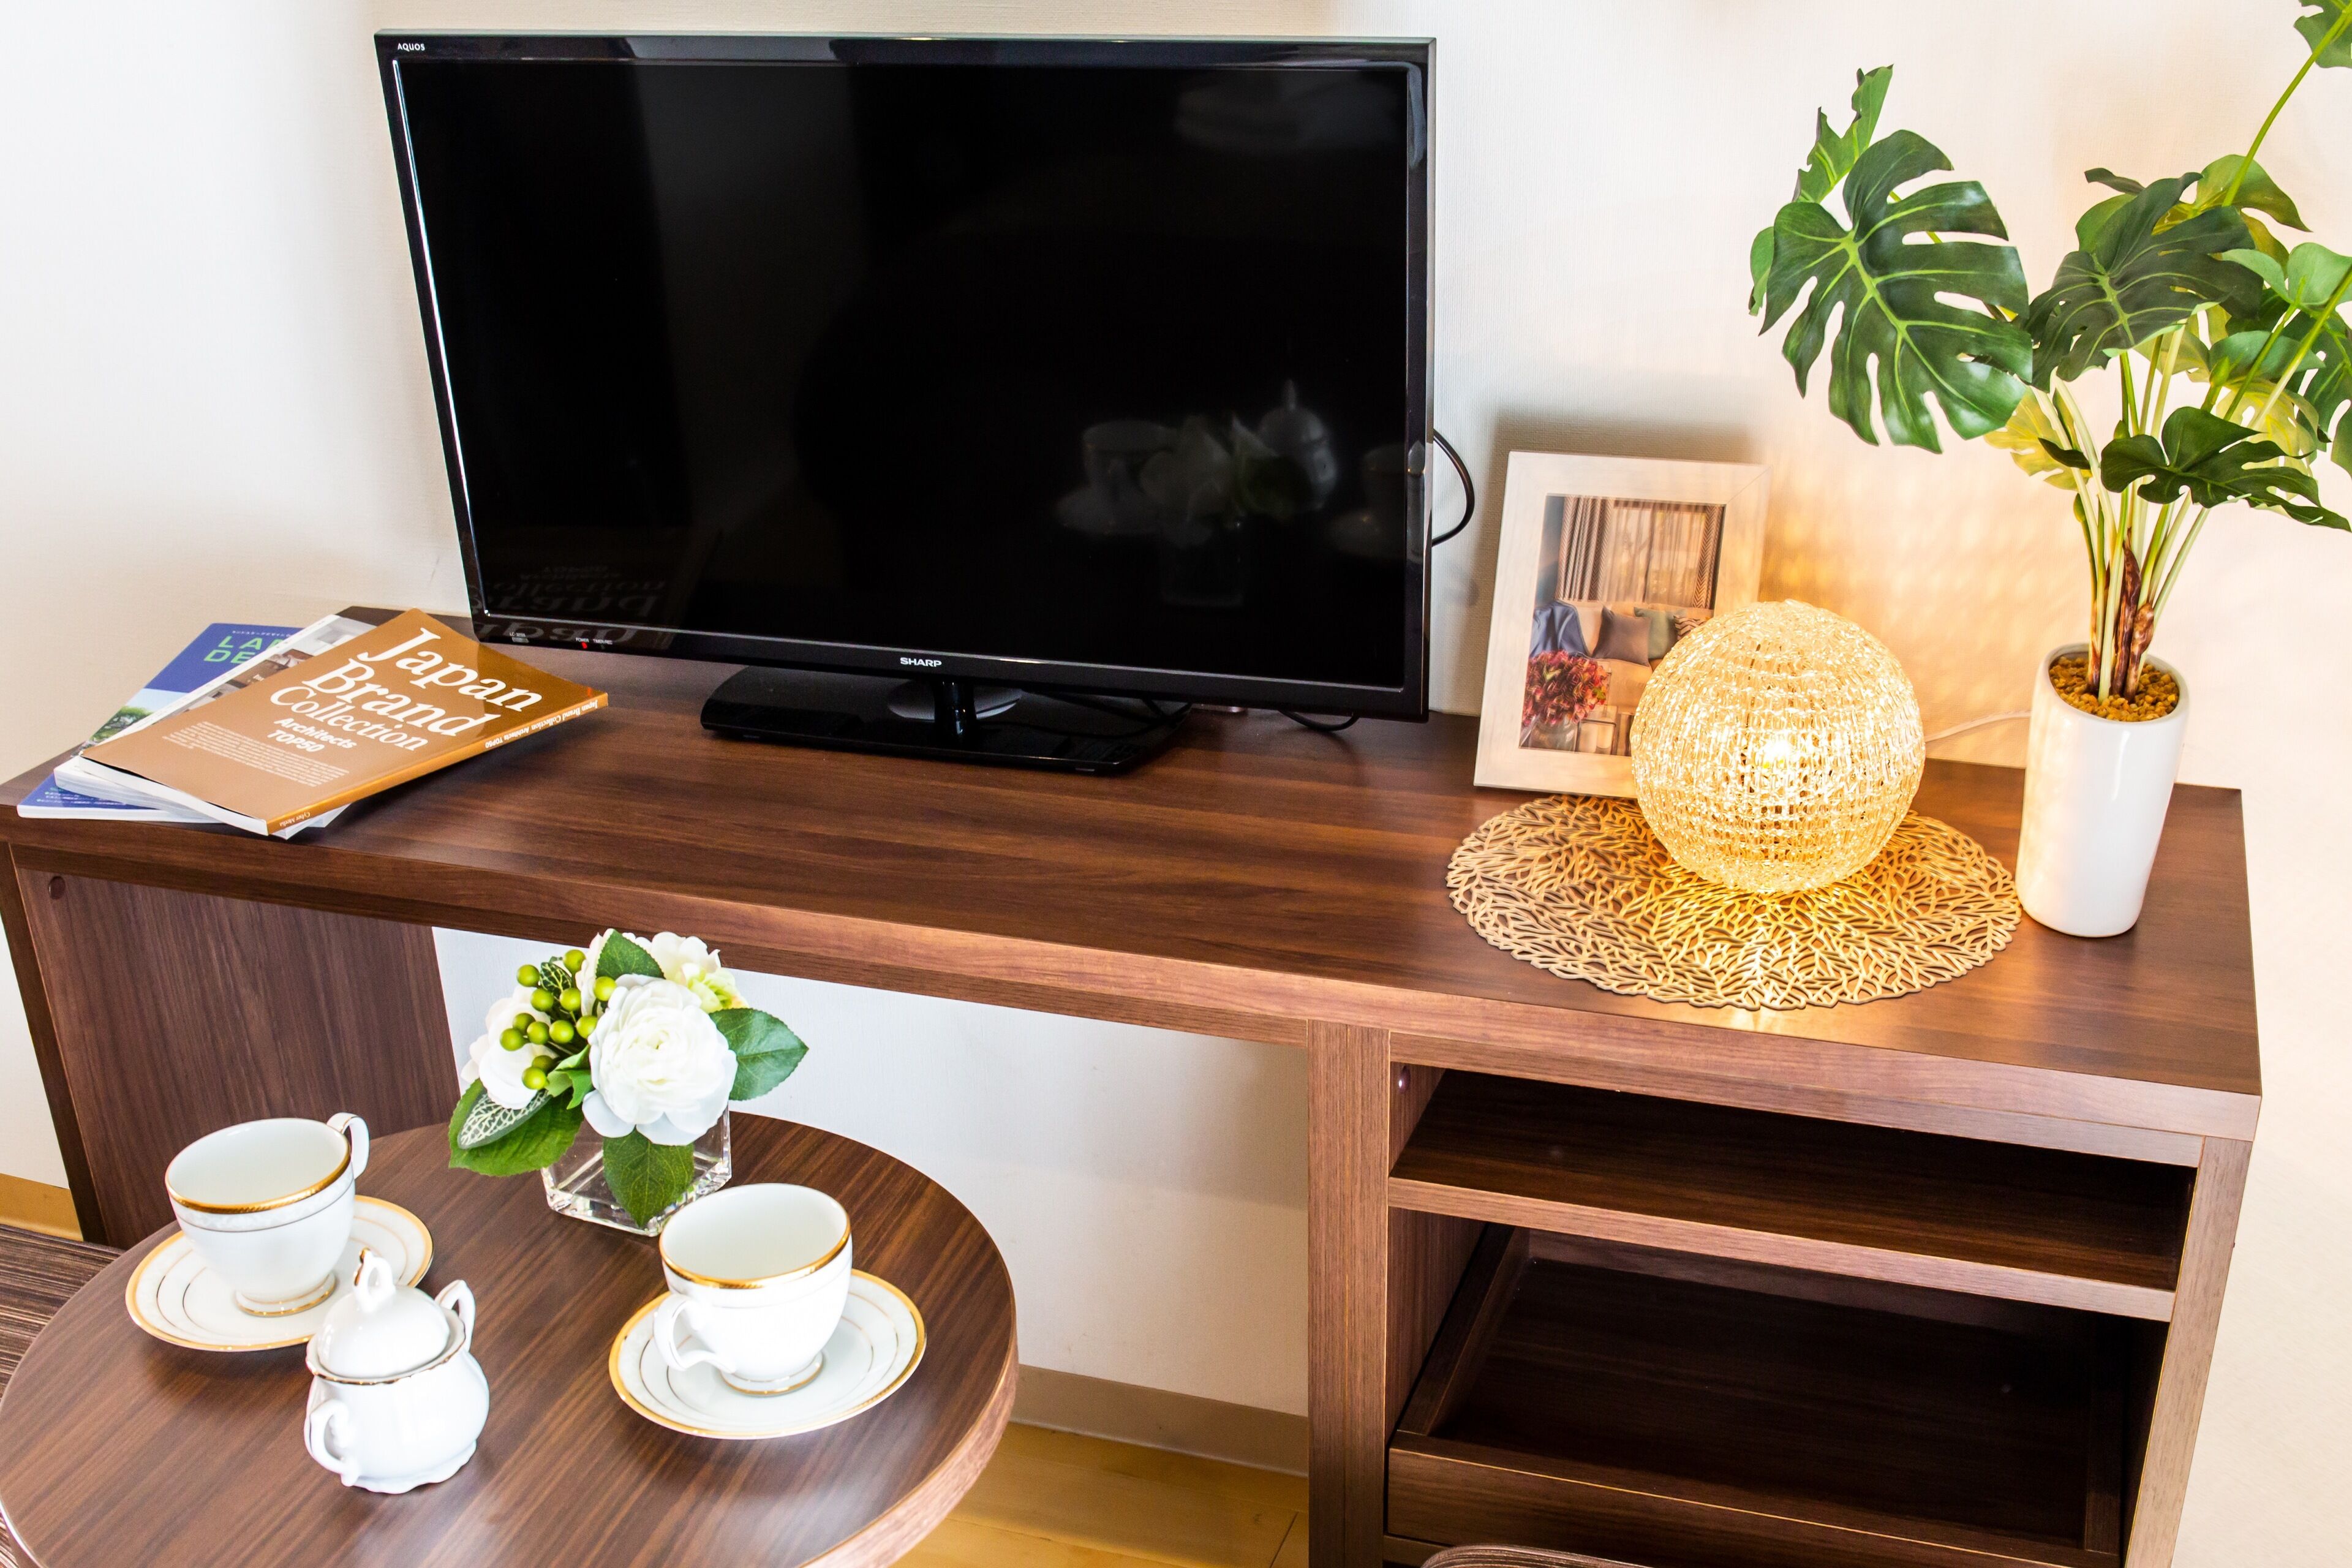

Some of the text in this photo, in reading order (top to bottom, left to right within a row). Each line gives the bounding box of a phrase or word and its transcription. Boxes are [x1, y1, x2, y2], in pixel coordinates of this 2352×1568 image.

[398, 43, 425, 51] AQUOS
[356, 627, 543, 712] Japan
[900, 657, 942, 667] SHARP
[301, 658, 501, 737] Brand
[270, 686, 429, 751] Collection
[273, 718, 357, 749] Architects
[485, 699, 598, 748] Japan Brand Collection Architects TOP50
[267, 729, 325, 752] TOP50
